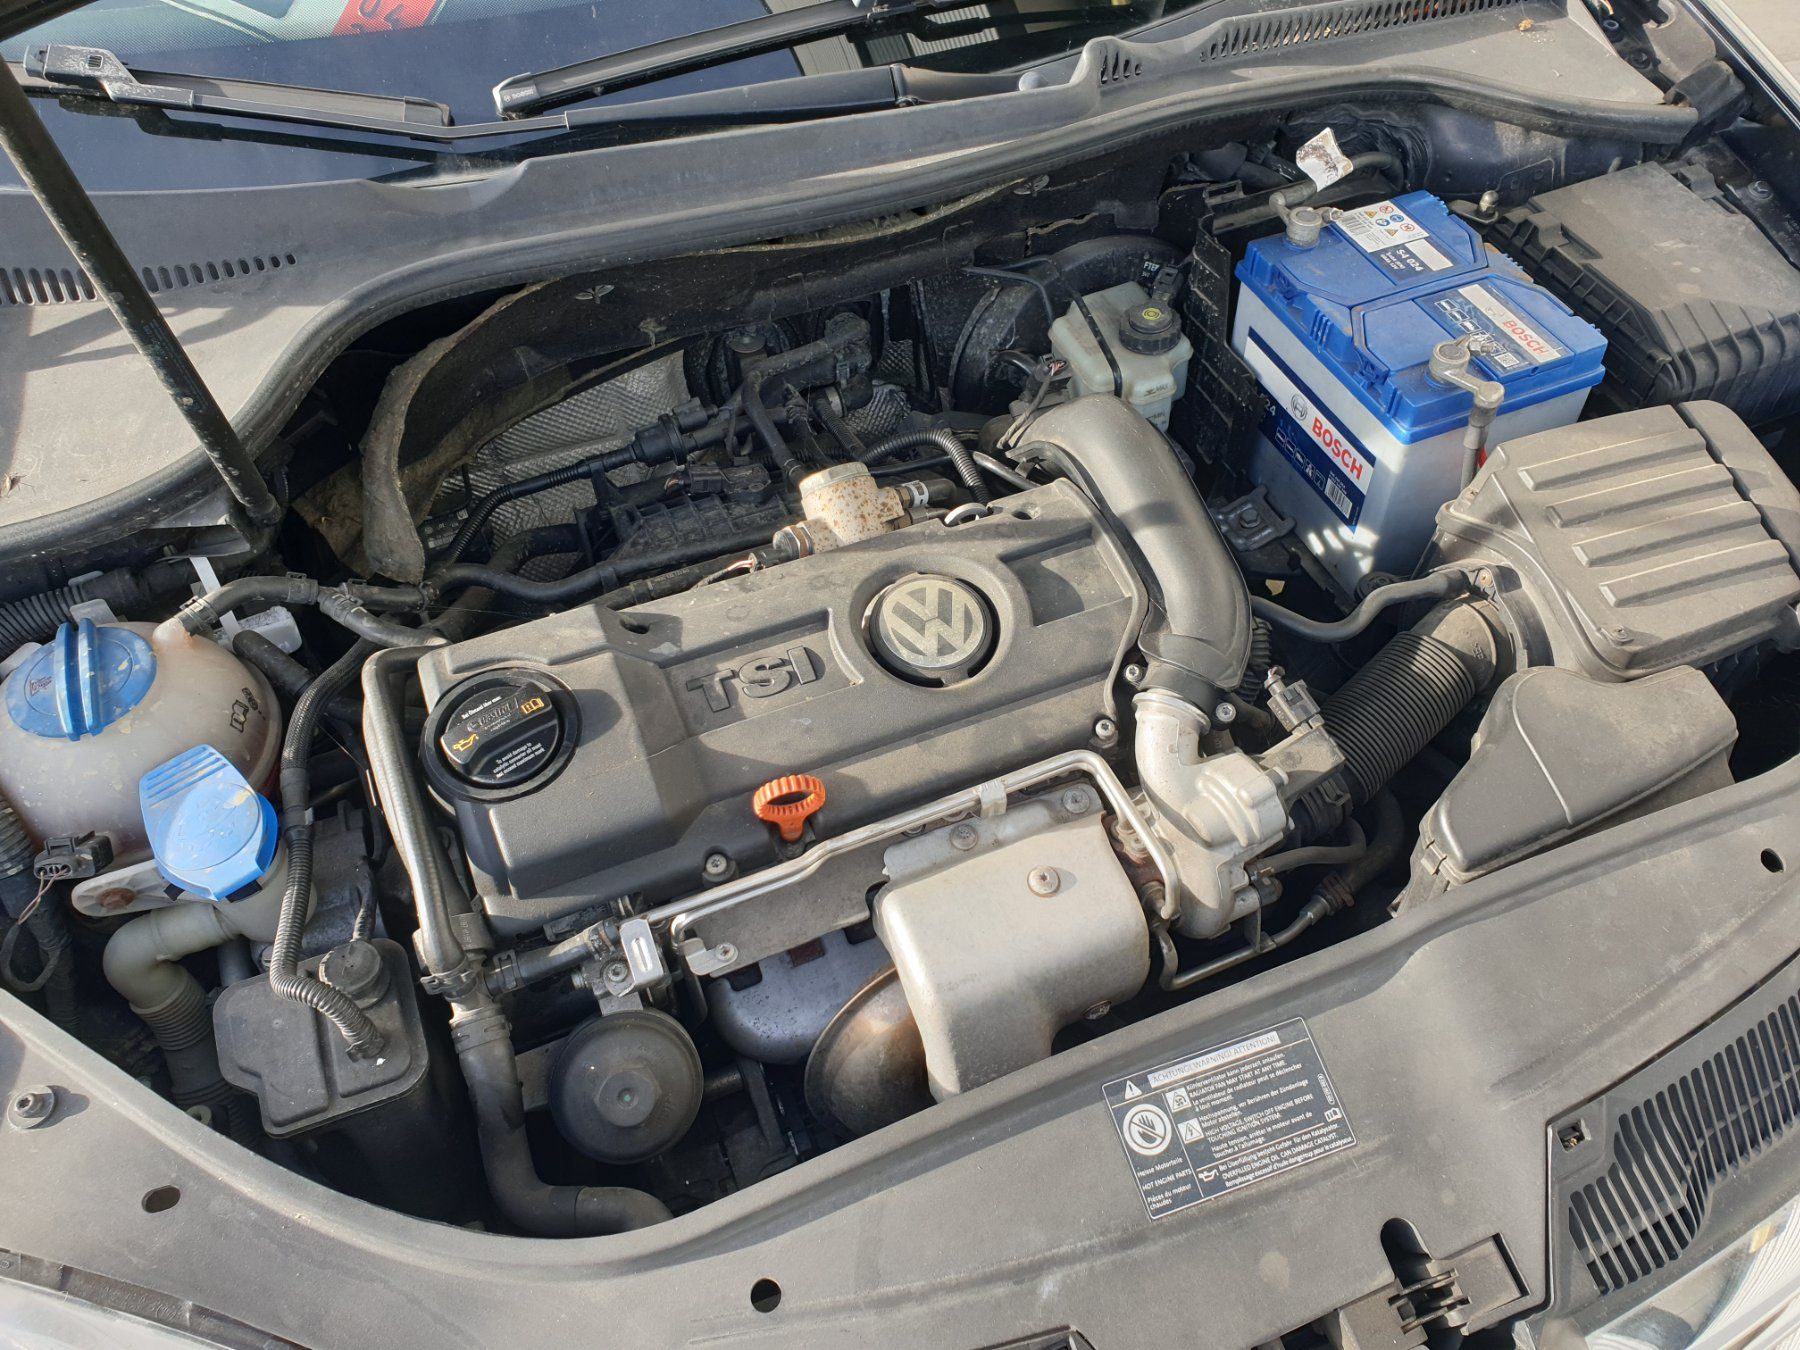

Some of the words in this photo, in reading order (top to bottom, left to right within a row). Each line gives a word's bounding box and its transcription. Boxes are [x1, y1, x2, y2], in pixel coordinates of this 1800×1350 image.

[1396, 249, 1409, 260] S4
[1407, 258, 1424, 272] 024
[1503, 320, 1549, 354] BOSCH
[1311, 416, 1363, 480] BOSCH
[686, 645, 817, 713] TSI
[501, 752, 512, 761] avoid
[511, 744, 527, 756] damage
[531, 742, 541, 750] must
[533, 746, 545, 755] mark
[1198, 1089, 1226, 1102] ventilateur
[1233, 1078, 1257, 1090] radiateur
[1256, 1074, 1269, 1083] peut
[1275, 1062, 1302, 1076] déclencher
[1214, 1080, 1226, 1088] FAN
[1225, 1076, 1238, 1084] MAY
[1238, 1071, 1253, 1080] START
[1260, 1064, 1272, 1072] ANY
[1225, 1067, 1239, 1076] kann
[1198, 1101, 1210, 1109] tout
[1204, 1126, 1219, 1136] HIGH
[1243, 1110, 1264, 1122] SWITCH
[1274, 1100, 1294, 1111] ENGINE
[1293, 1093, 1314, 1104] BEFORE
[1201, 1117, 1217, 1127] Motor
[1207, 1128, 1236, 1143] TOUCHING
[1235, 1119, 1260, 1133] IGNITION
[1210, 1141, 1228, 1152] Haute
[1271, 1119, 1291, 1130] moteur
[1290, 1113, 1305, 1123] avant
[1213, 1147, 1234, 1158] toucher
[1275, 1139, 1292, 1150] Gefahr
[1154, 1156, 1183, 1171] Motorteile
[1221, 1163, 1251, 1179] OVERFILLED
[1250, 1156, 1270, 1168] ENGINE
[1279, 1149, 1292, 1157] CAN
[1291, 1141, 1314, 1153] DAMAGE
[1224, 1171, 1255, 1188] Remplissage
[1253, 1164, 1273, 1176] excessif
[1312, 1146, 1325, 1156] pour
[1141, 1181, 1154, 1190] HOT
[1154, 1174, 1175, 1186] ENGINE
[1174, 1168, 1191, 1179] PARTS
[1171, 1181, 1191, 1194] moteur
[1149, 1196, 1172, 1210] chaudes
